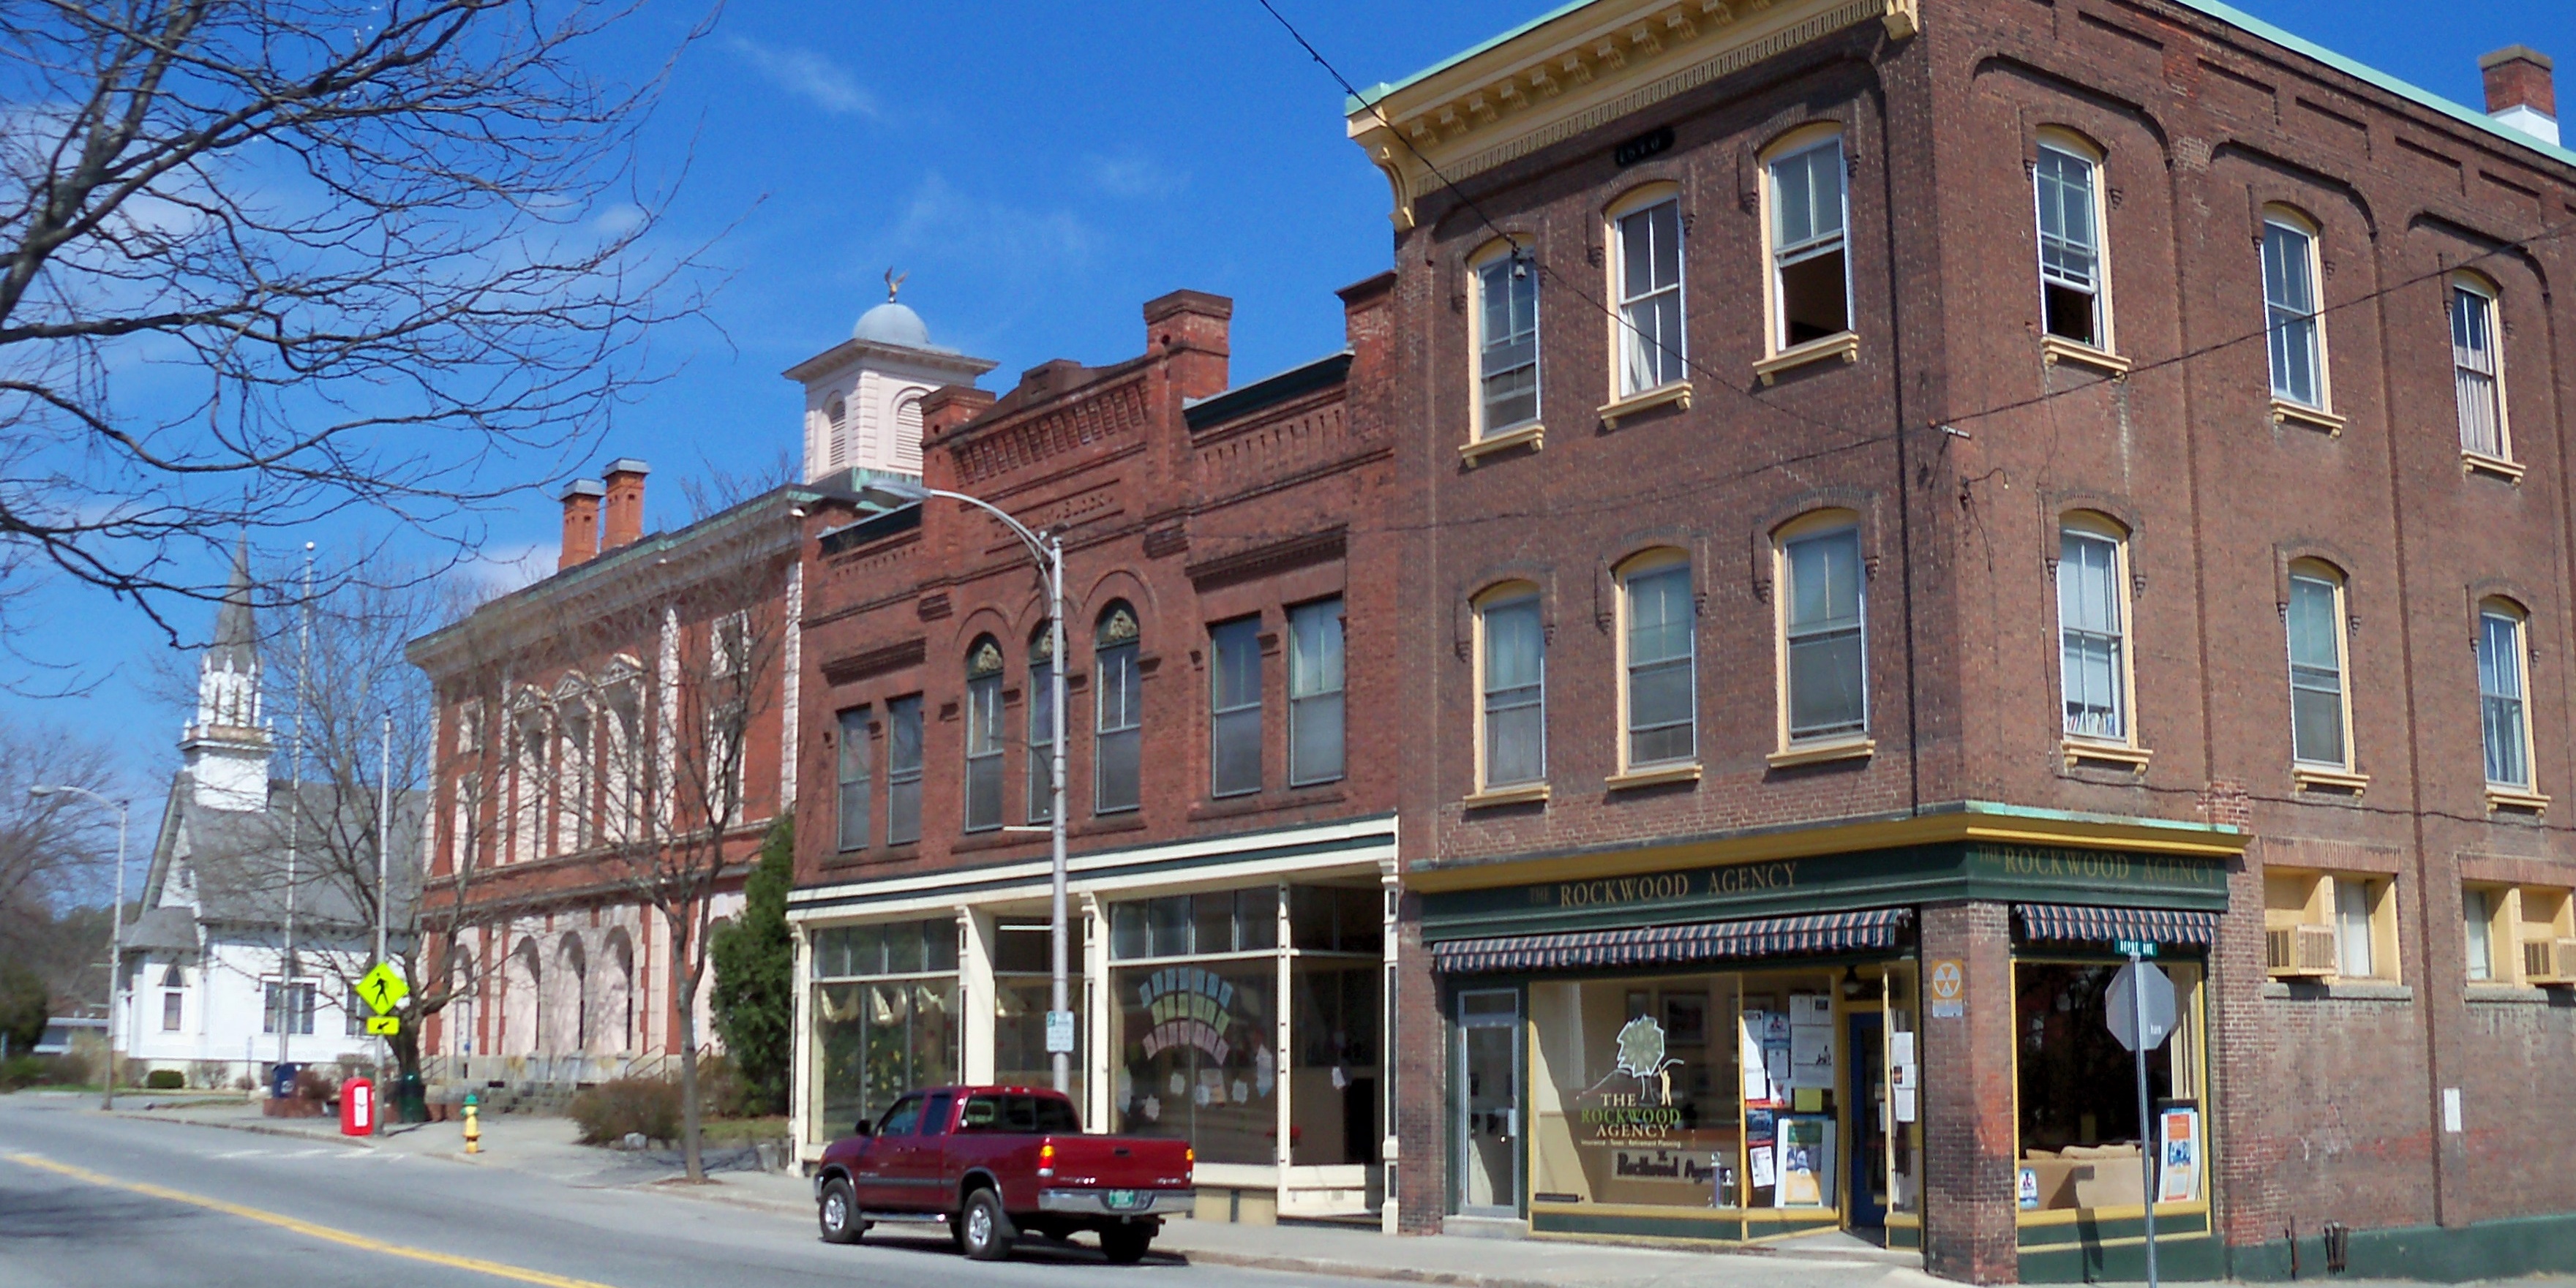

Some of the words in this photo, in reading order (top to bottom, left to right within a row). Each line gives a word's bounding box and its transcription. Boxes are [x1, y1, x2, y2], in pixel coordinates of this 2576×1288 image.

[1978, 844, 2001, 865] THE
[2004, 846, 2130, 879] ROCKWOOD
[2143, 856, 2215, 884] AGENCY
[1559, 873, 1689, 908] ROCKWOOD
[1707, 861, 1798, 895] AGENCY
[1599, 1093, 1637, 1107] THE
[1580, 1107, 1681, 1124] ROCKWOOD
[1596, 1123, 1670, 1138] AGENCY
